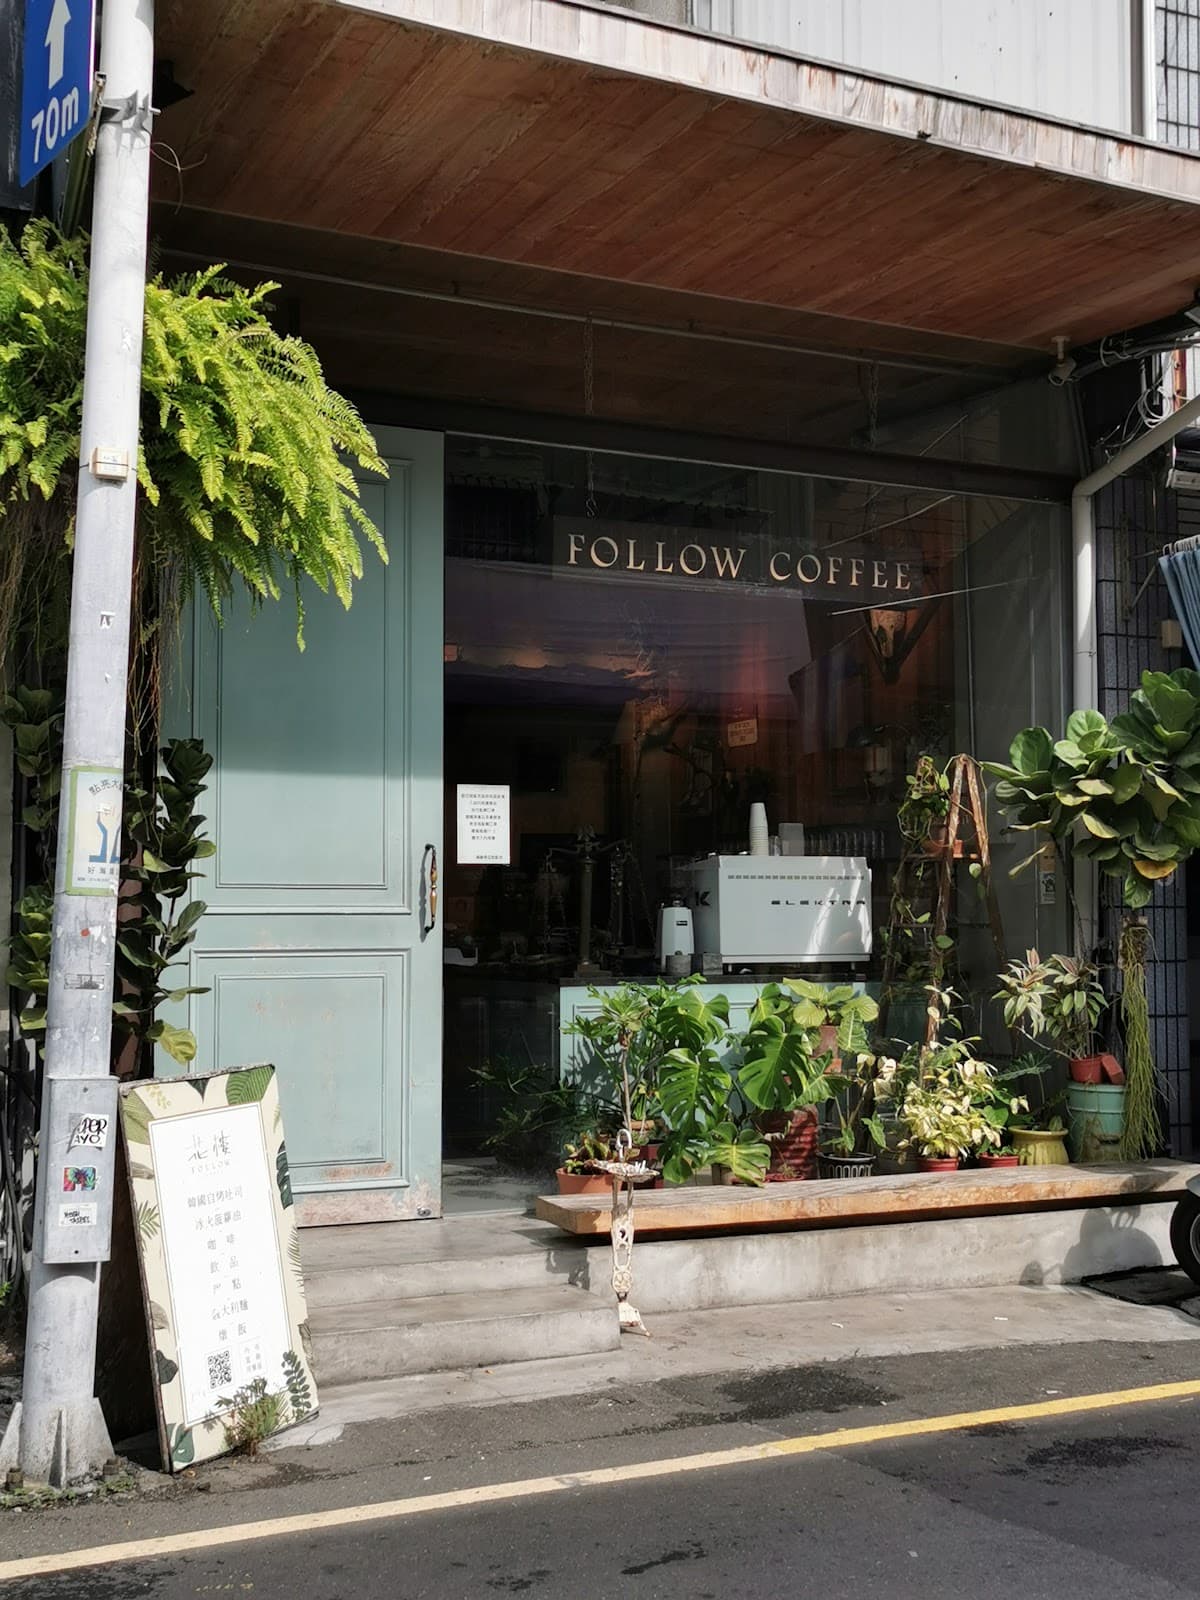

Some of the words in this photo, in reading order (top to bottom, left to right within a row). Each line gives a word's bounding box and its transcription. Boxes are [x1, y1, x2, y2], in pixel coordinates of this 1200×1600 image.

[31, 86, 79, 164] 70m
[567, 533, 748, 580] FOLLOW
[769, 551, 913, 591] COFFEE
